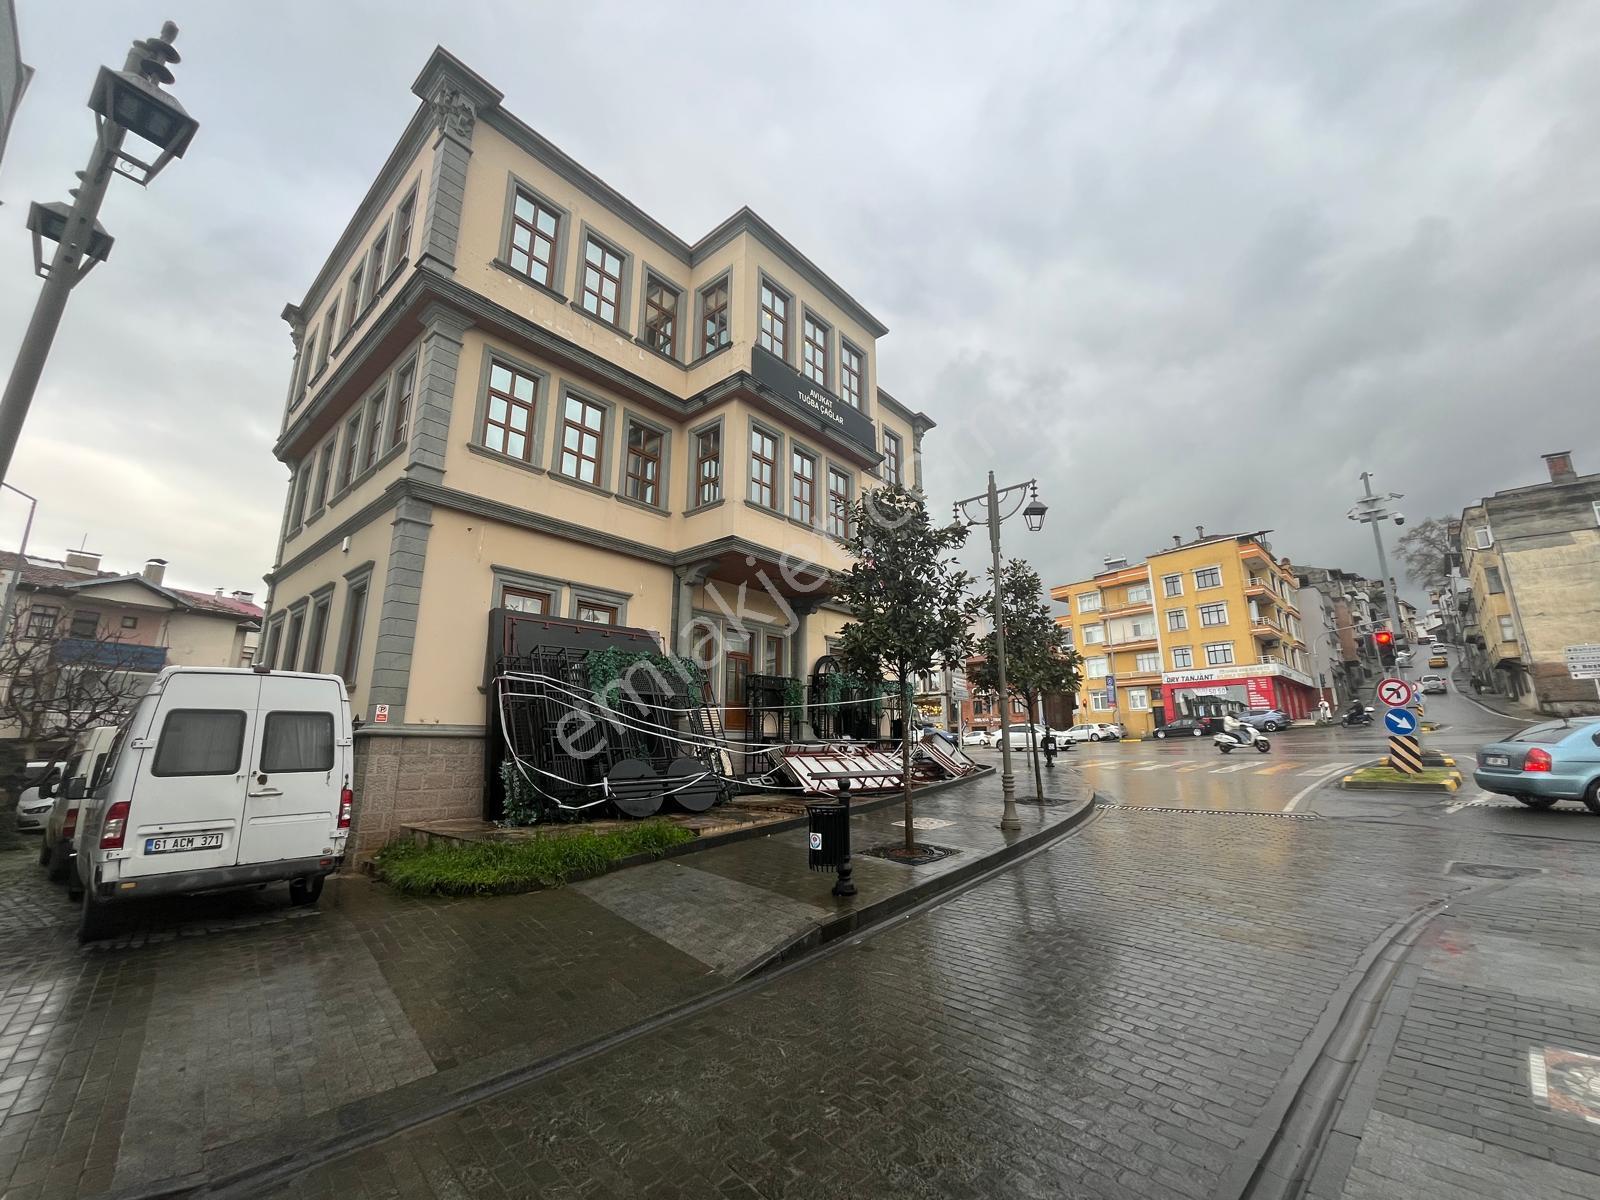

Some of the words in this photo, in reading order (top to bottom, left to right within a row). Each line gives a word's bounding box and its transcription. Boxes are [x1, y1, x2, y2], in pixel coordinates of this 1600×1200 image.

[809, 389, 833, 408] AVUKAT
[797, 390, 820, 411] TUĞBA
[820, 405, 844, 425] ÇAĞLAR
[1181, 673, 1214, 682] TANJANT
[154, 839, 167, 850] 61
[172, 837, 195, 848] ACM
[201, 835, 220, 846] 371
